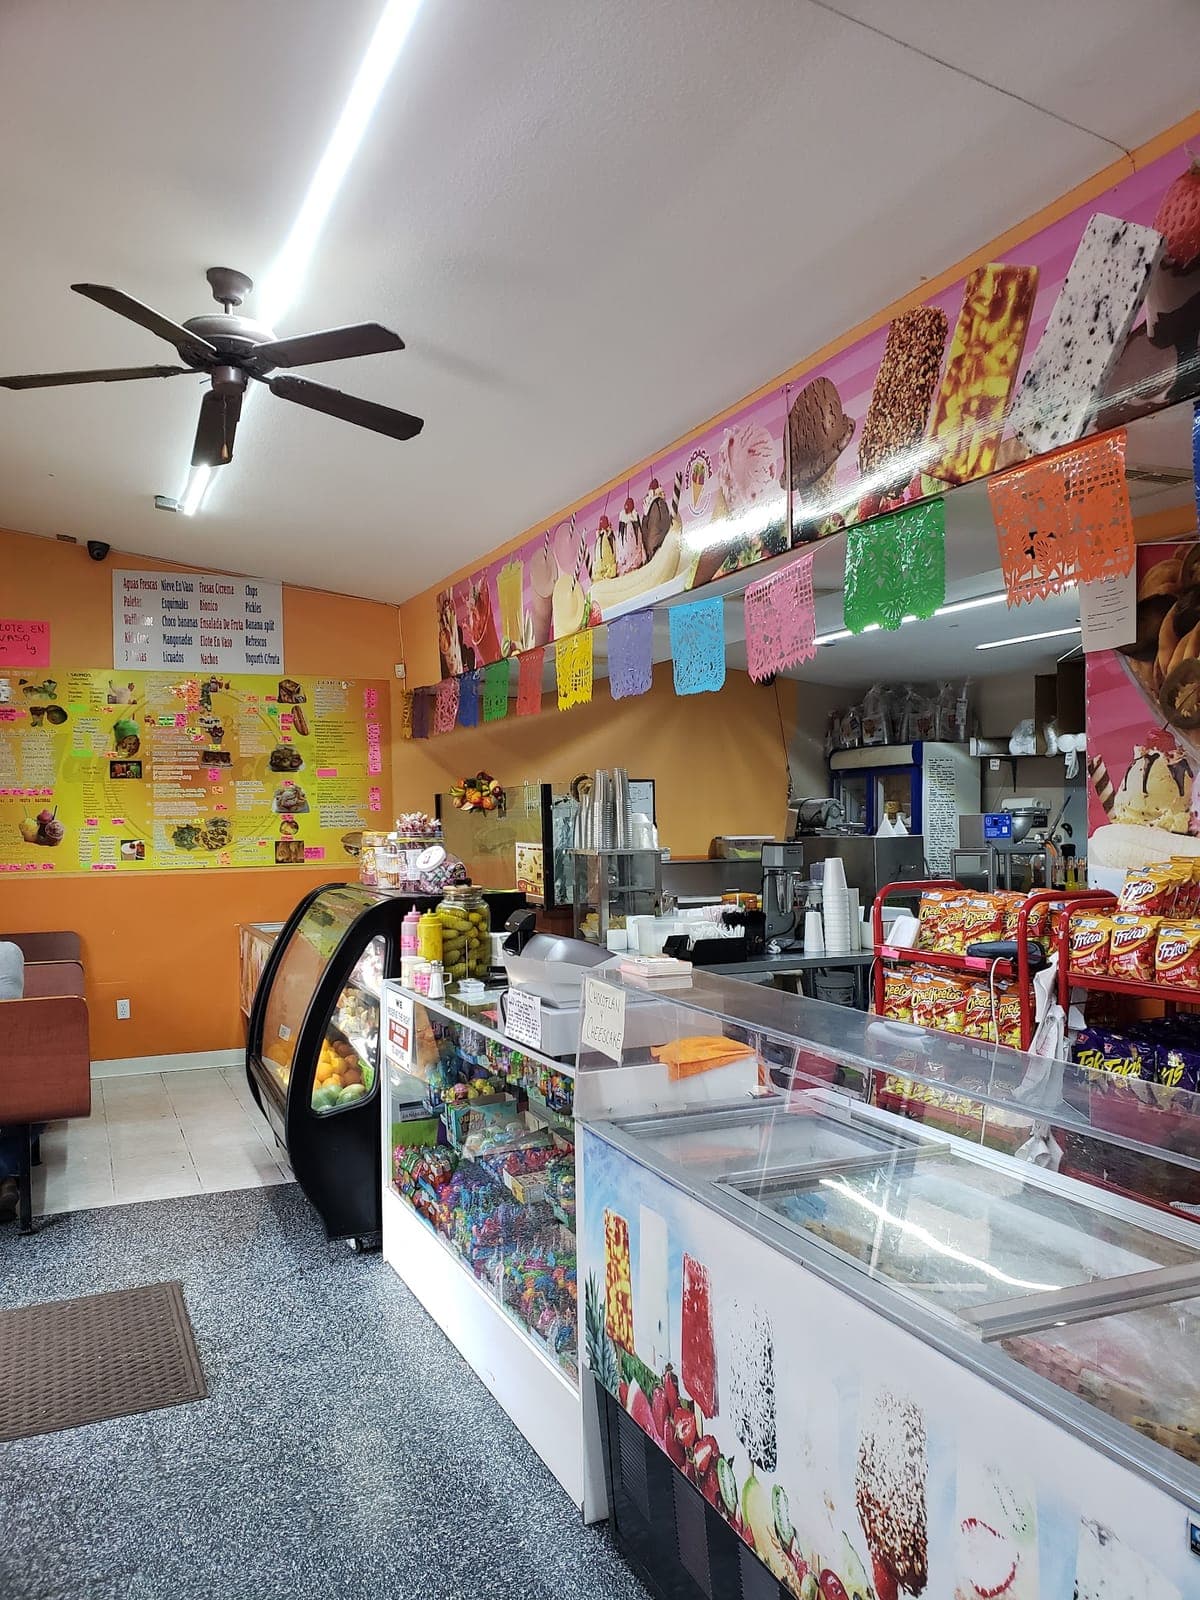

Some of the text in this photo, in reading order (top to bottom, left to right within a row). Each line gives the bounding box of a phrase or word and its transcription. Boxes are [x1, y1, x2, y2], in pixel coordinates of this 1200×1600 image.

[123, 577, 158, 591] Aguas Frescas
[161, 579, 194, 592] Nieve En Vaso
[199, 582, 214, 594] Fresas
[245, 585, 258, 598] Chips
[245, 601, 262, 613] Pickles
[162, 615, 198, 628] Choco bananas
[200, 617, 244, 630] Ensalada De Fruta
[245, 618, 275, 633] Banana split
[30, 624, 44, 633] EN
[162, 633, 193, 648] Mangonadas
[200, 635, 232, 648] Elote En Vaso
[245, 635, 267, 647] Refrescos
[162, 651, 184, 663] Licuados
[200, 652, 218, 665] Nachos
[1123, 881, 1156, 903] Fritos
[1073, 931, 1104, 950] Fritos
[1113, 925, 1149, 947] Fritos
[1159, 940, 1191, 961] Fritos
